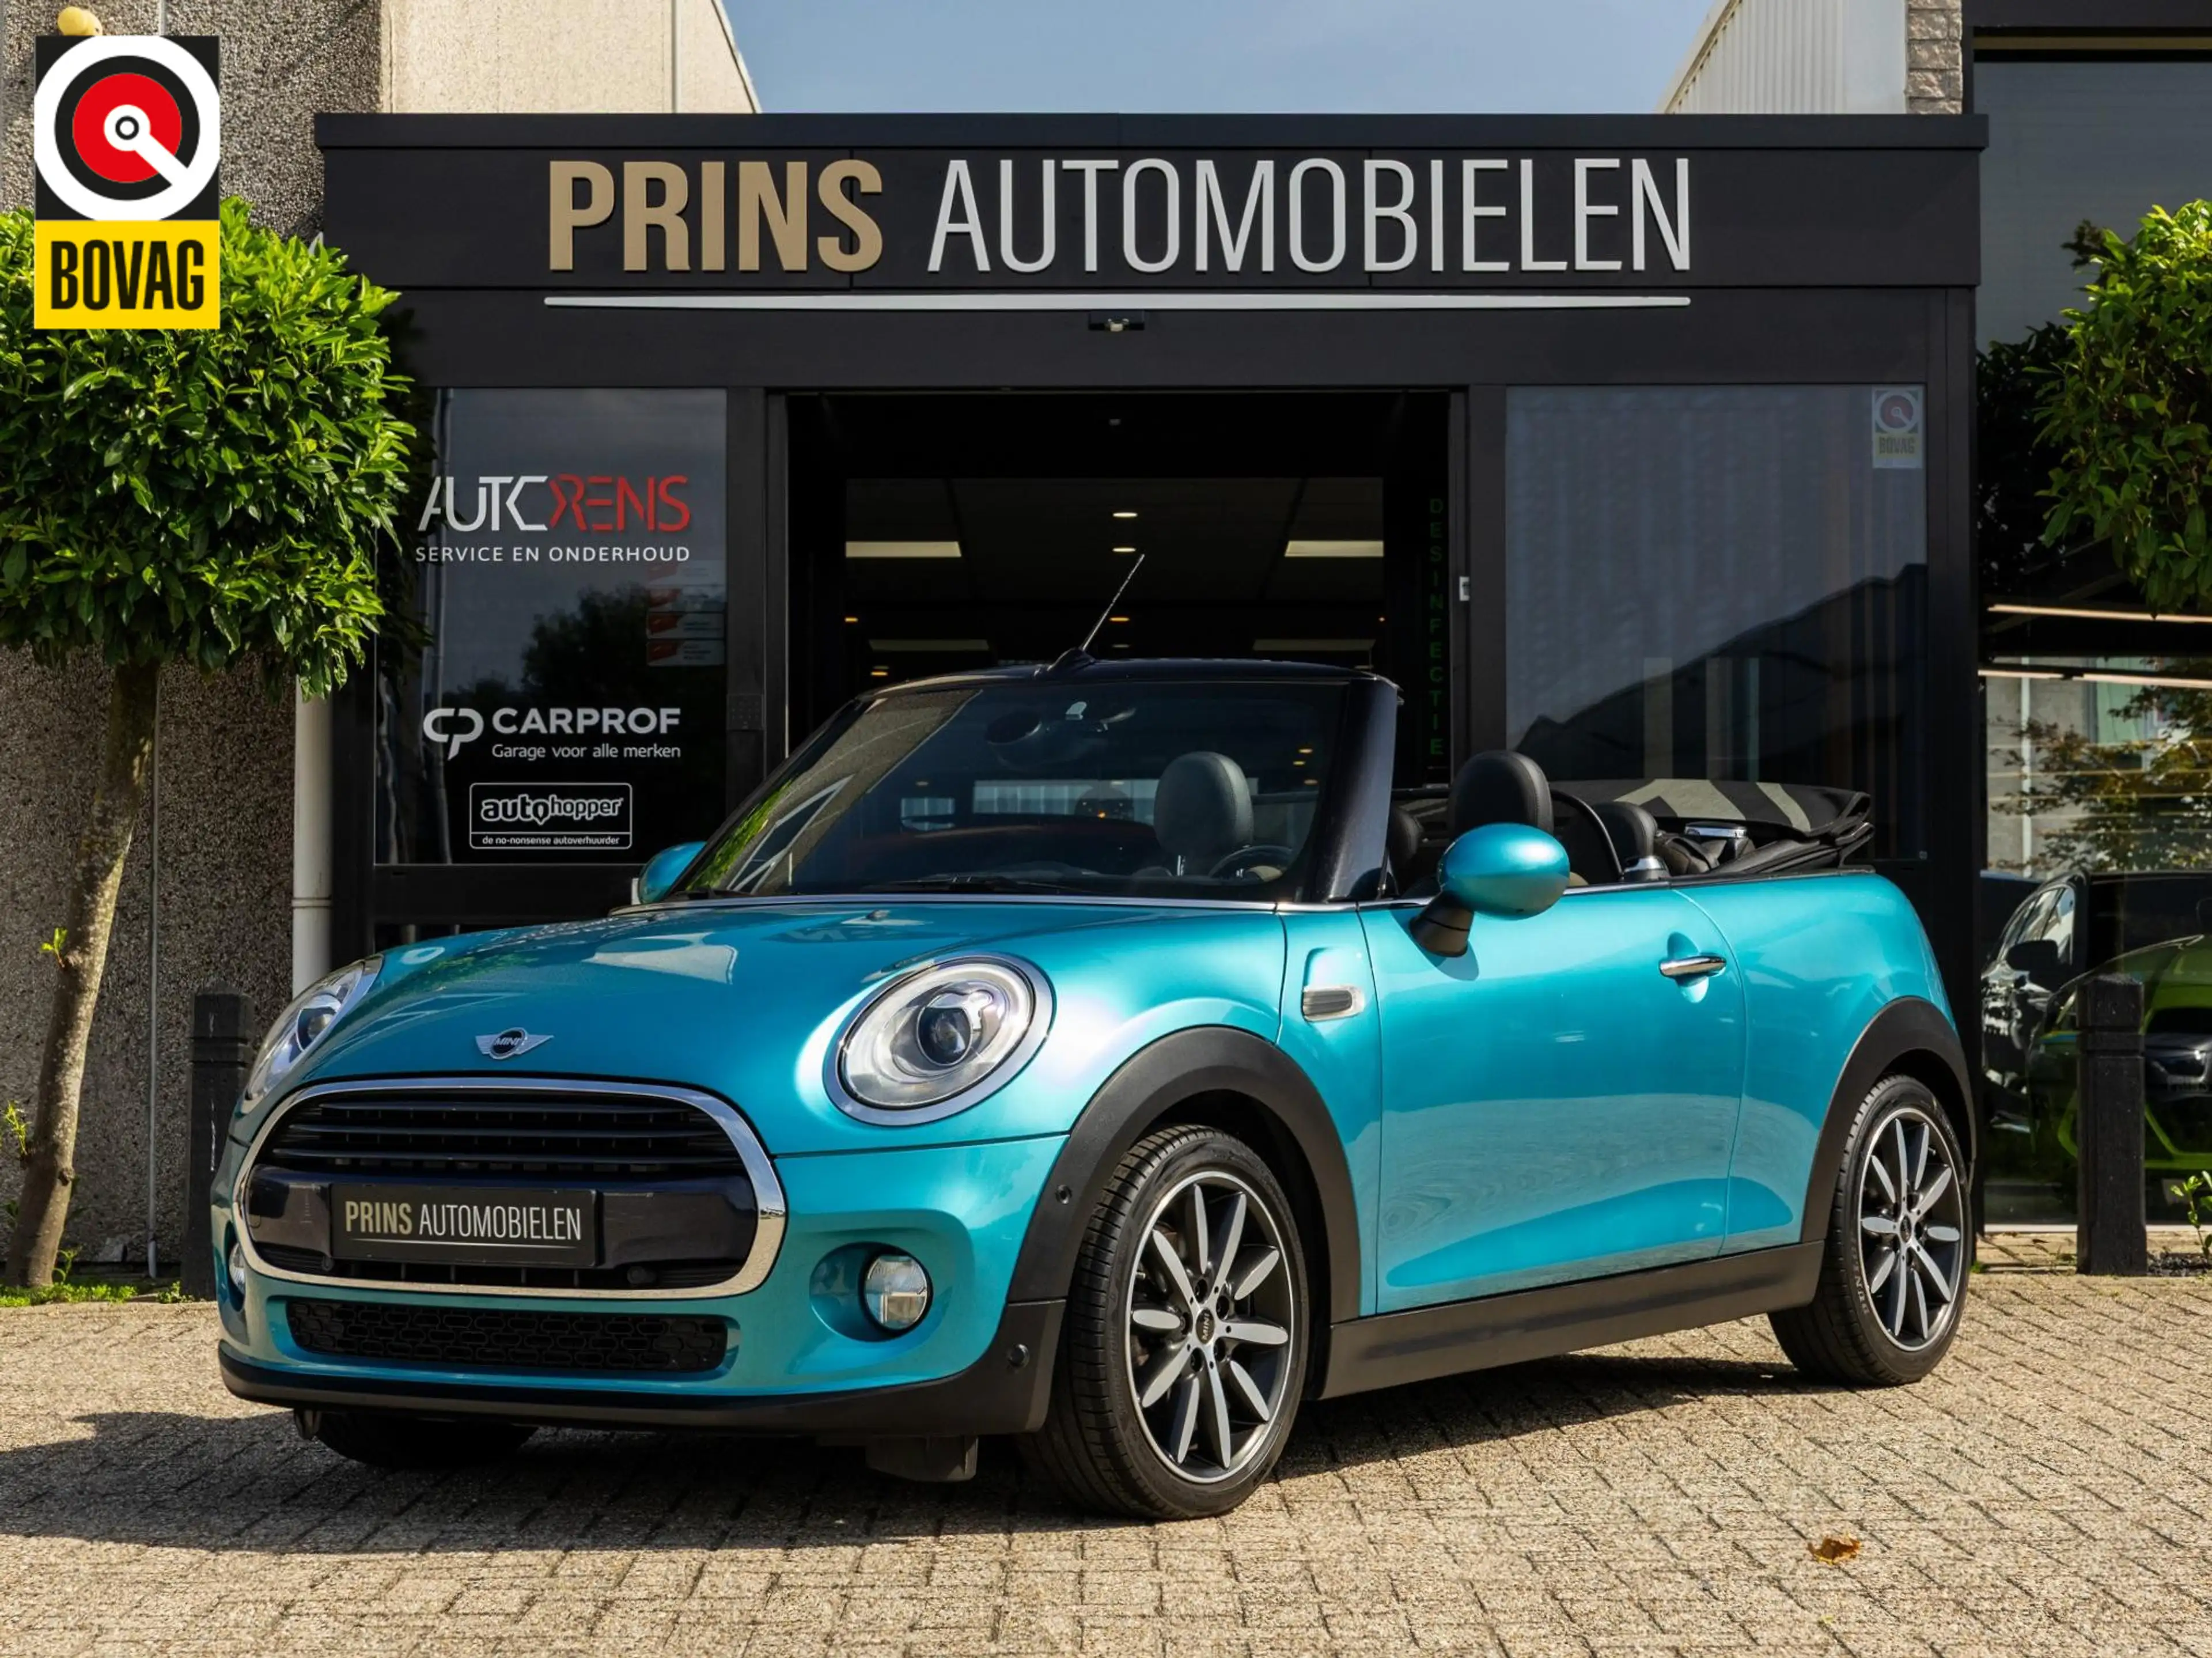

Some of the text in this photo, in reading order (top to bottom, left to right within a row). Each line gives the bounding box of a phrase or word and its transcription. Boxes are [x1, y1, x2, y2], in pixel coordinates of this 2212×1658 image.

[549, 157, 1691, 273] PRINS AUTOMOBIELEN
[1878, 436, 1915, 455] BOVAG
[415, 546, 690, 562] SERVICE EN ONDERHOUD
[1429, 498, 1444, 755] DESINFECTIE
[491, 707, 681, 735] CARPROF
[491, 743, 681, 761] Garage voor alle merken
[480, 793, 624, 826] autohopper
[482, 835, 620, 845] de no-nonsense autoverhuurder
[494, 1037, 523, 1046] MINI
[345, 1200, 581, 1241] PRINS AUTOMOBIELEN
